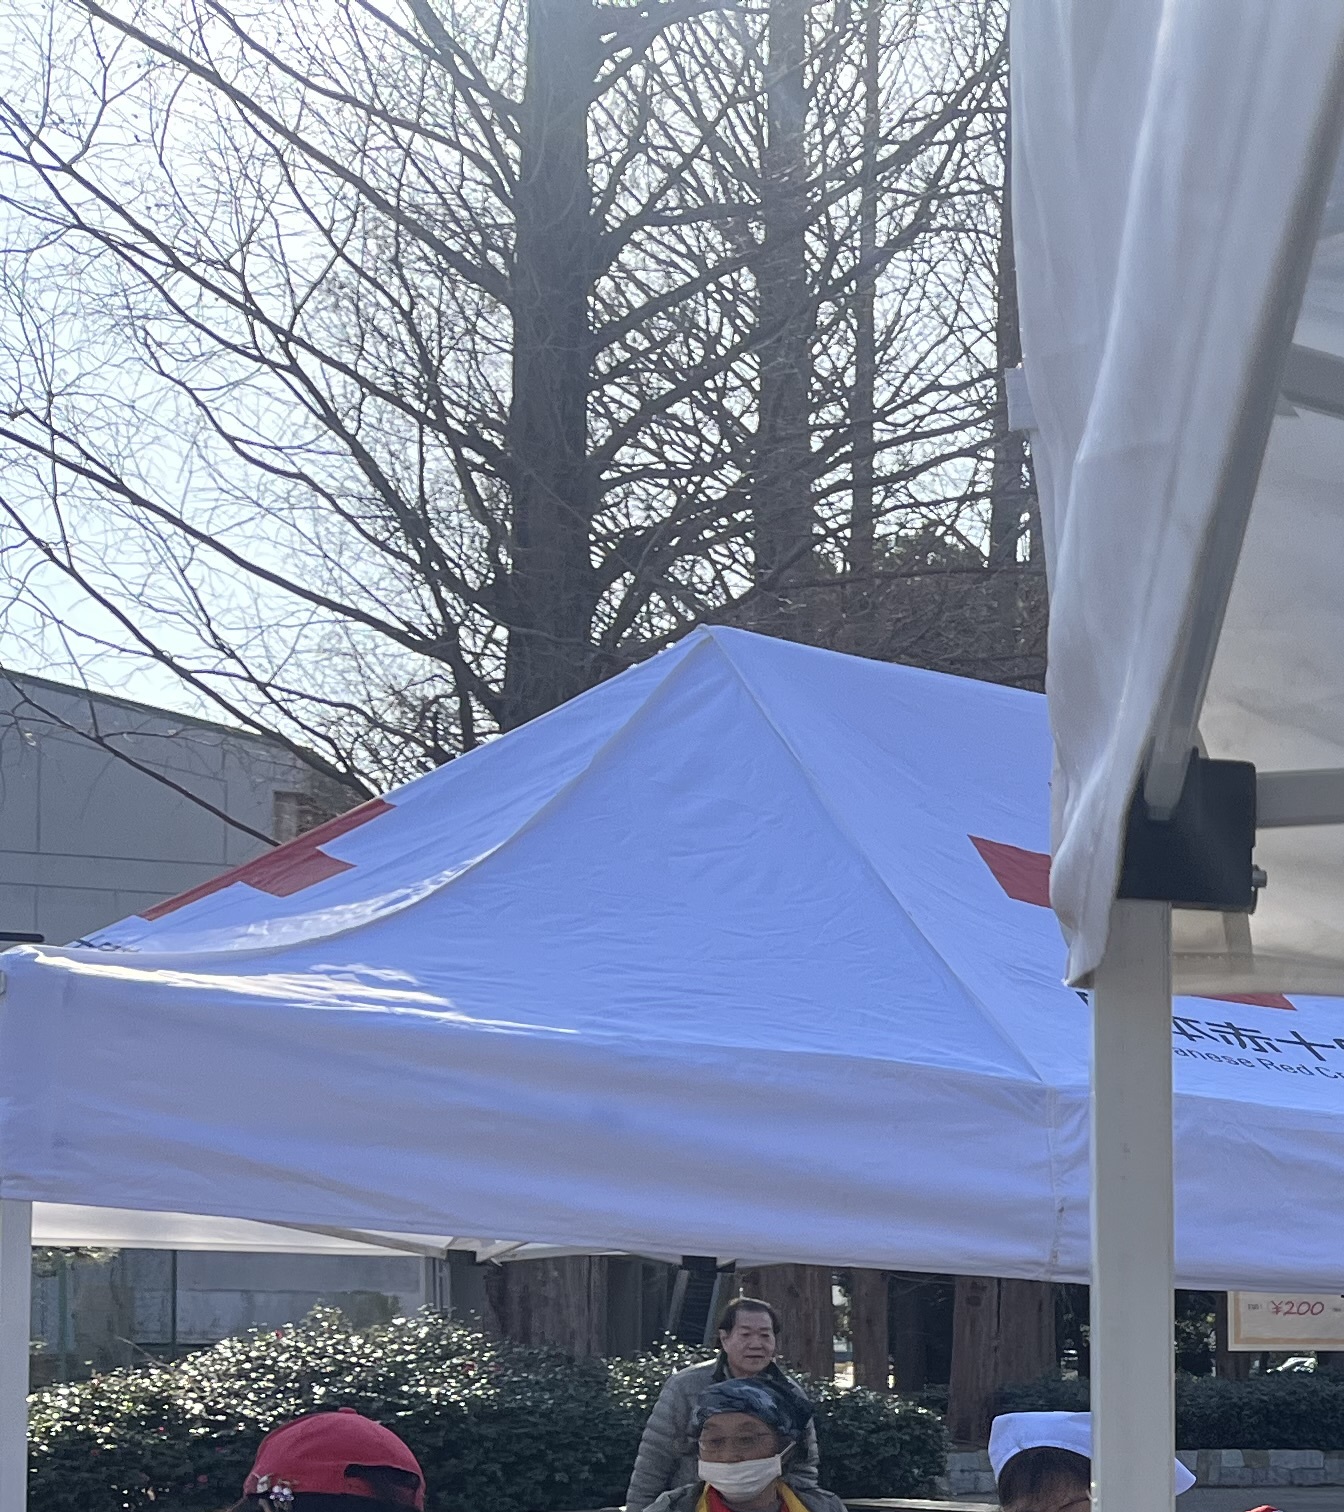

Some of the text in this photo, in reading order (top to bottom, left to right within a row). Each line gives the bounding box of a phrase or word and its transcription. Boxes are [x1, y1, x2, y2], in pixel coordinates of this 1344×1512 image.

[1172, 1047, 1255, 1068] anese
[1258, 1057, 1315, 1077] Red
[1271, 1300, 1325, 1316] ¥200
